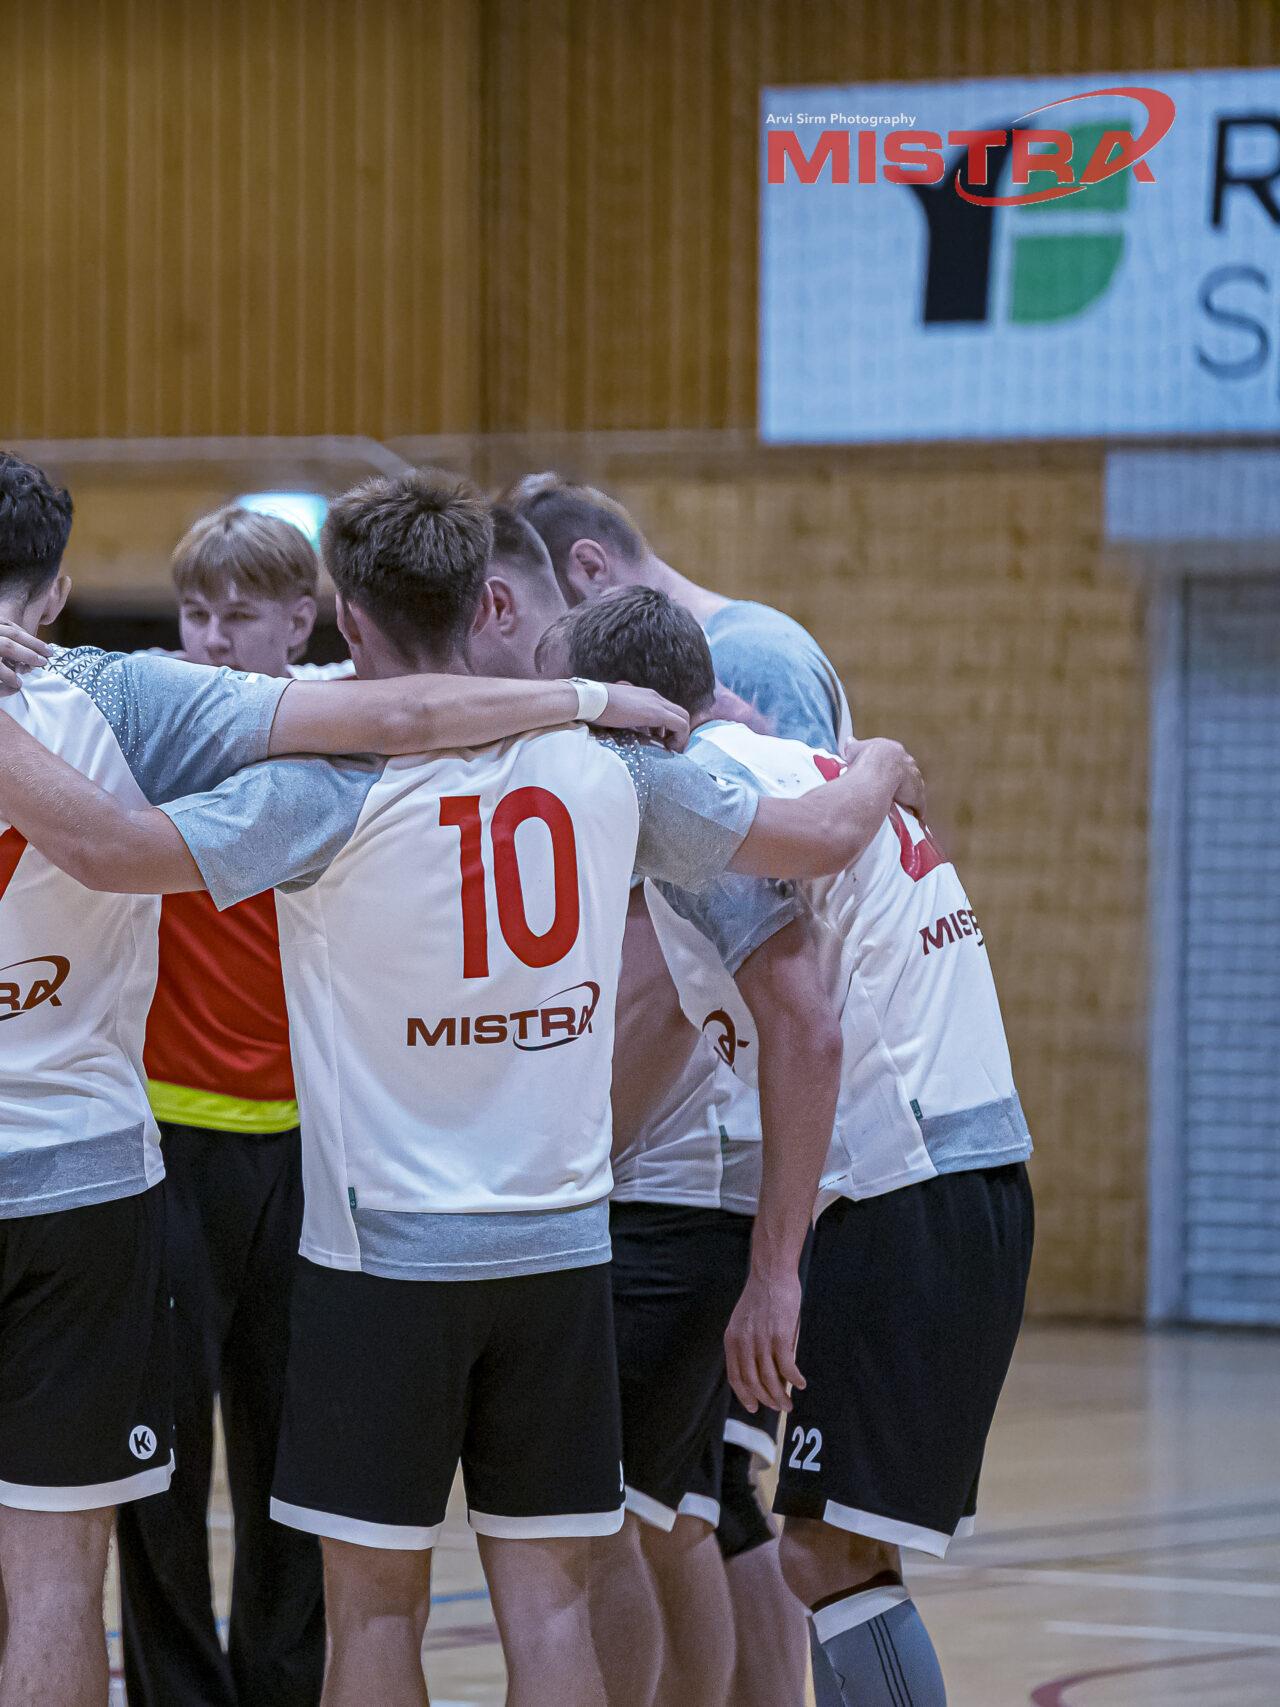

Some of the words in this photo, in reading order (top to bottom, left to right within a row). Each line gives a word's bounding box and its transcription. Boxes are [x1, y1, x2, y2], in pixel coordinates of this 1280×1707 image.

[1197, 265, 1278, 385] S
[438, 785, 581, 979] 10
[788, 1425, 823, 1472] 22
